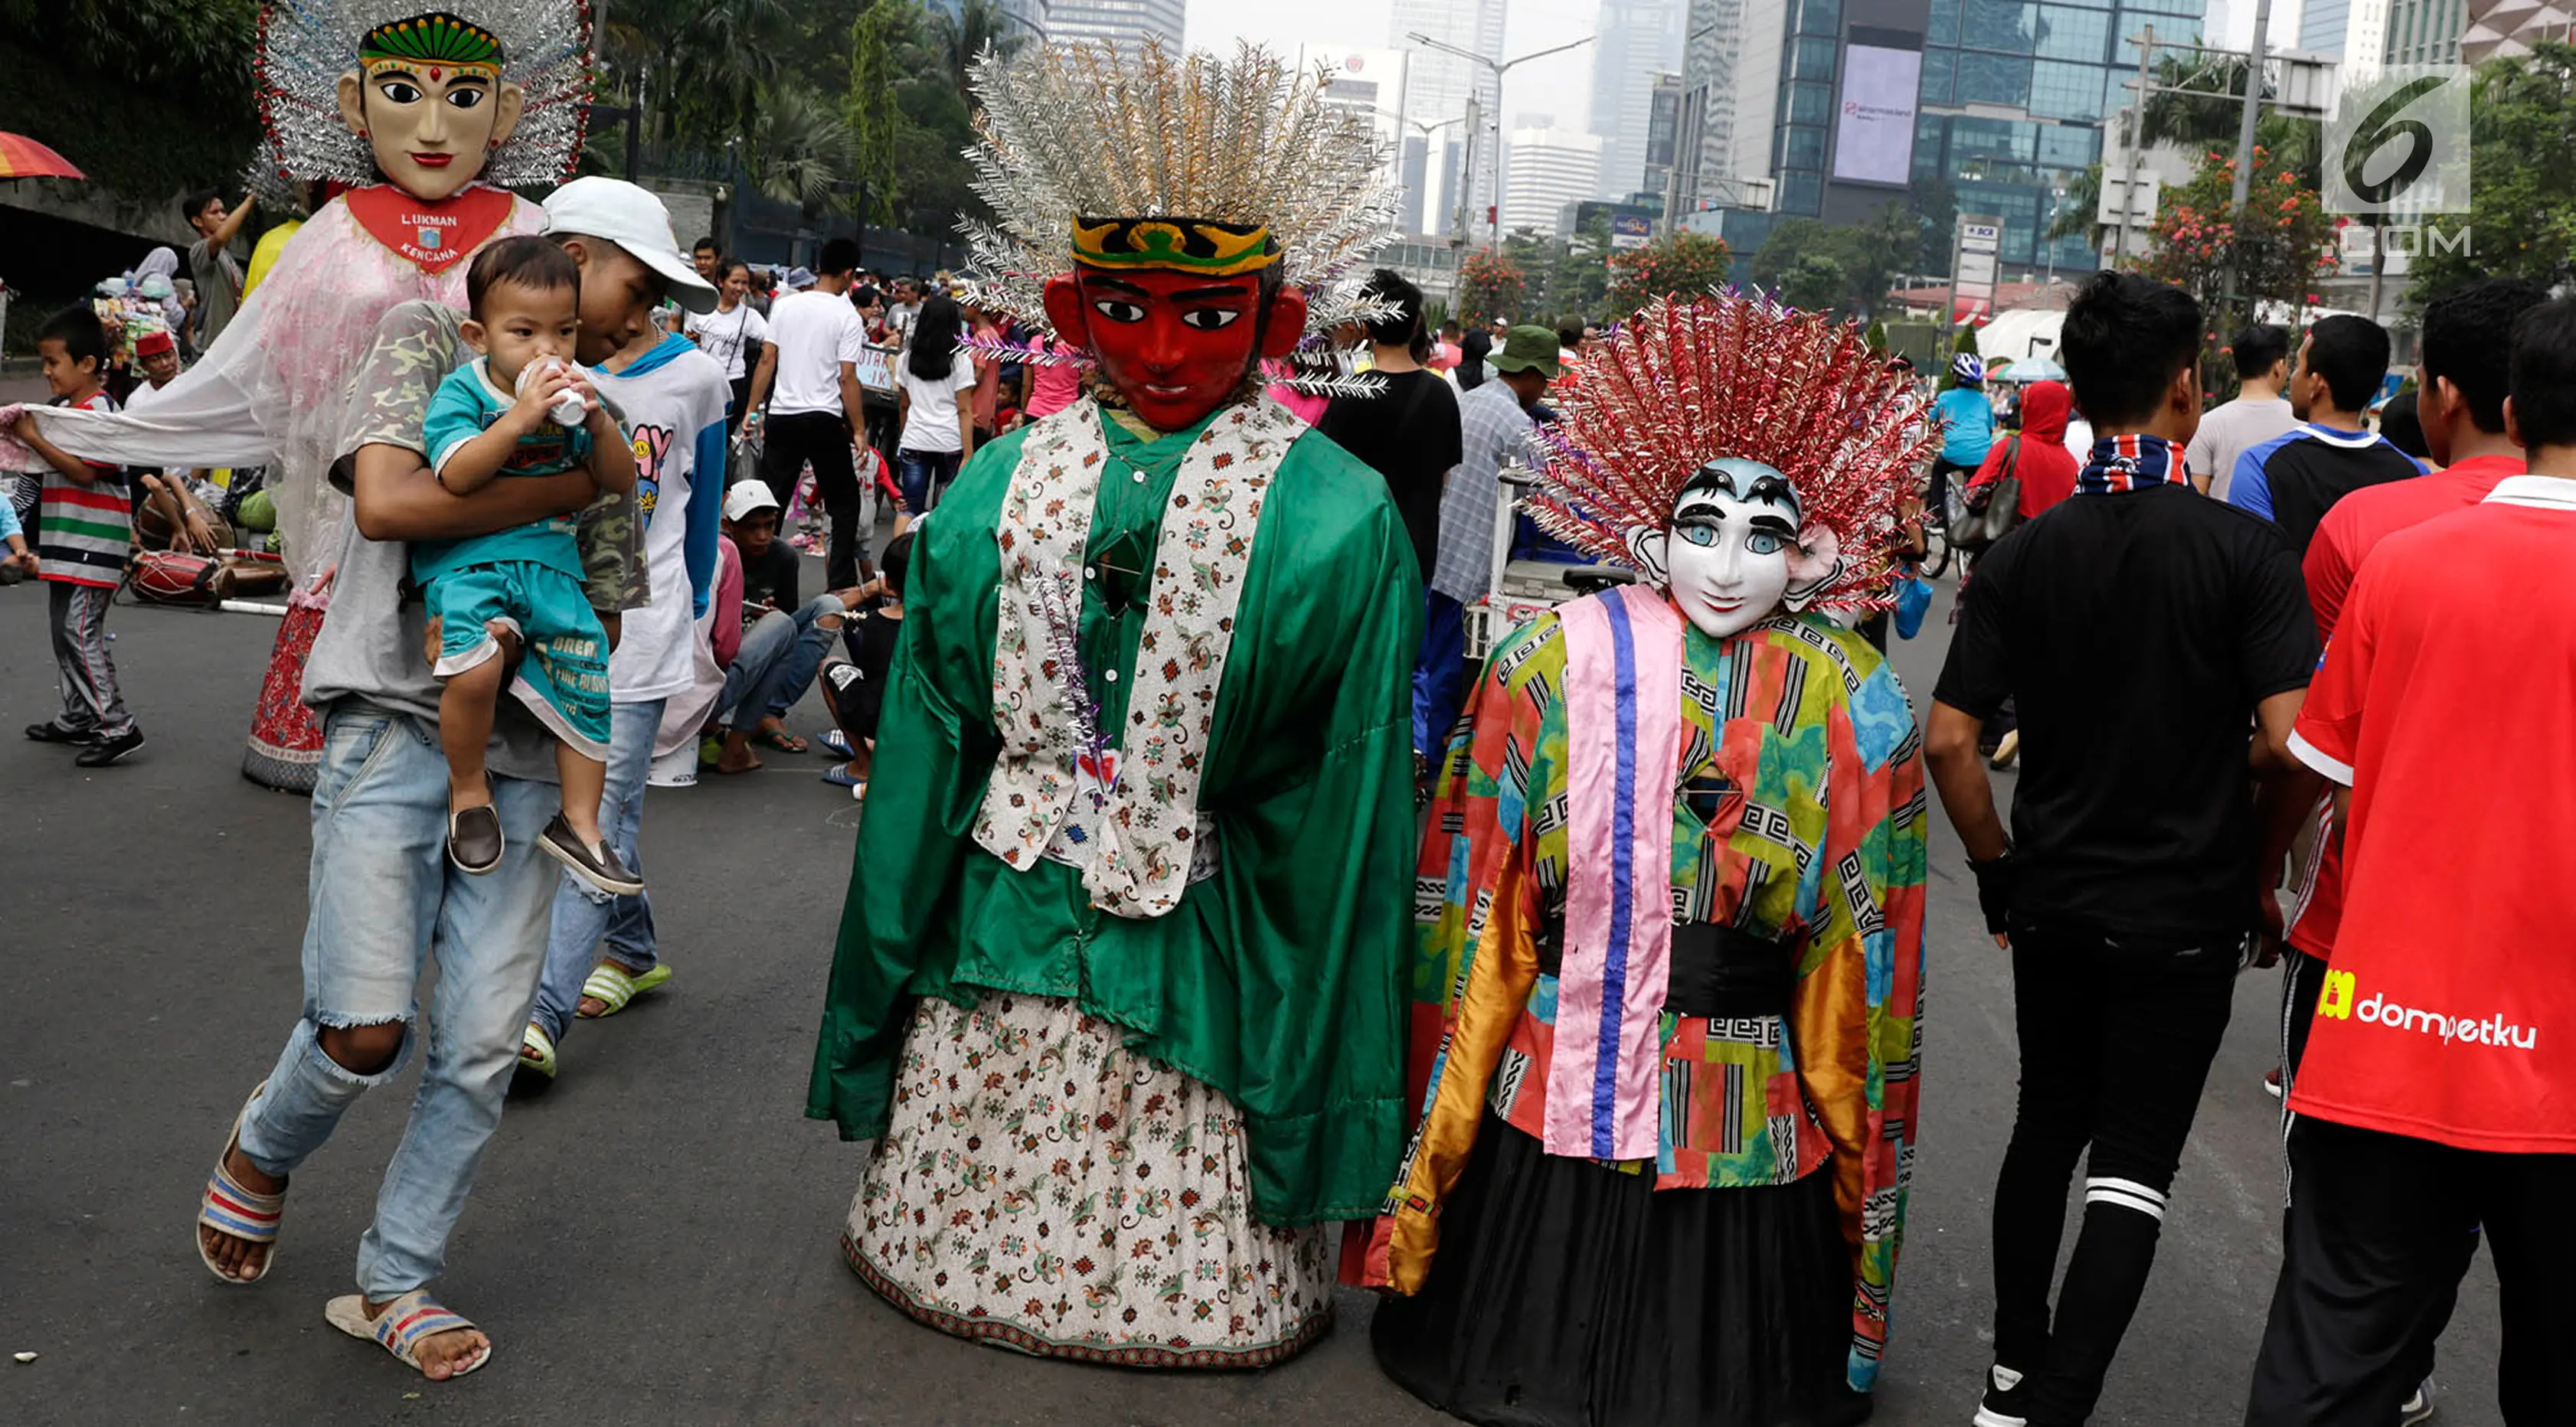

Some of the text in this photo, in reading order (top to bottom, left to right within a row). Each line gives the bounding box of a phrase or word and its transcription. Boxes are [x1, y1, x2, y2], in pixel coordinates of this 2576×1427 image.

[401, 214, 457, 227] LUKMAN
[400, 243, 459, 262] KENCANA
[2356, 992, 2537, 1050] dompetku
